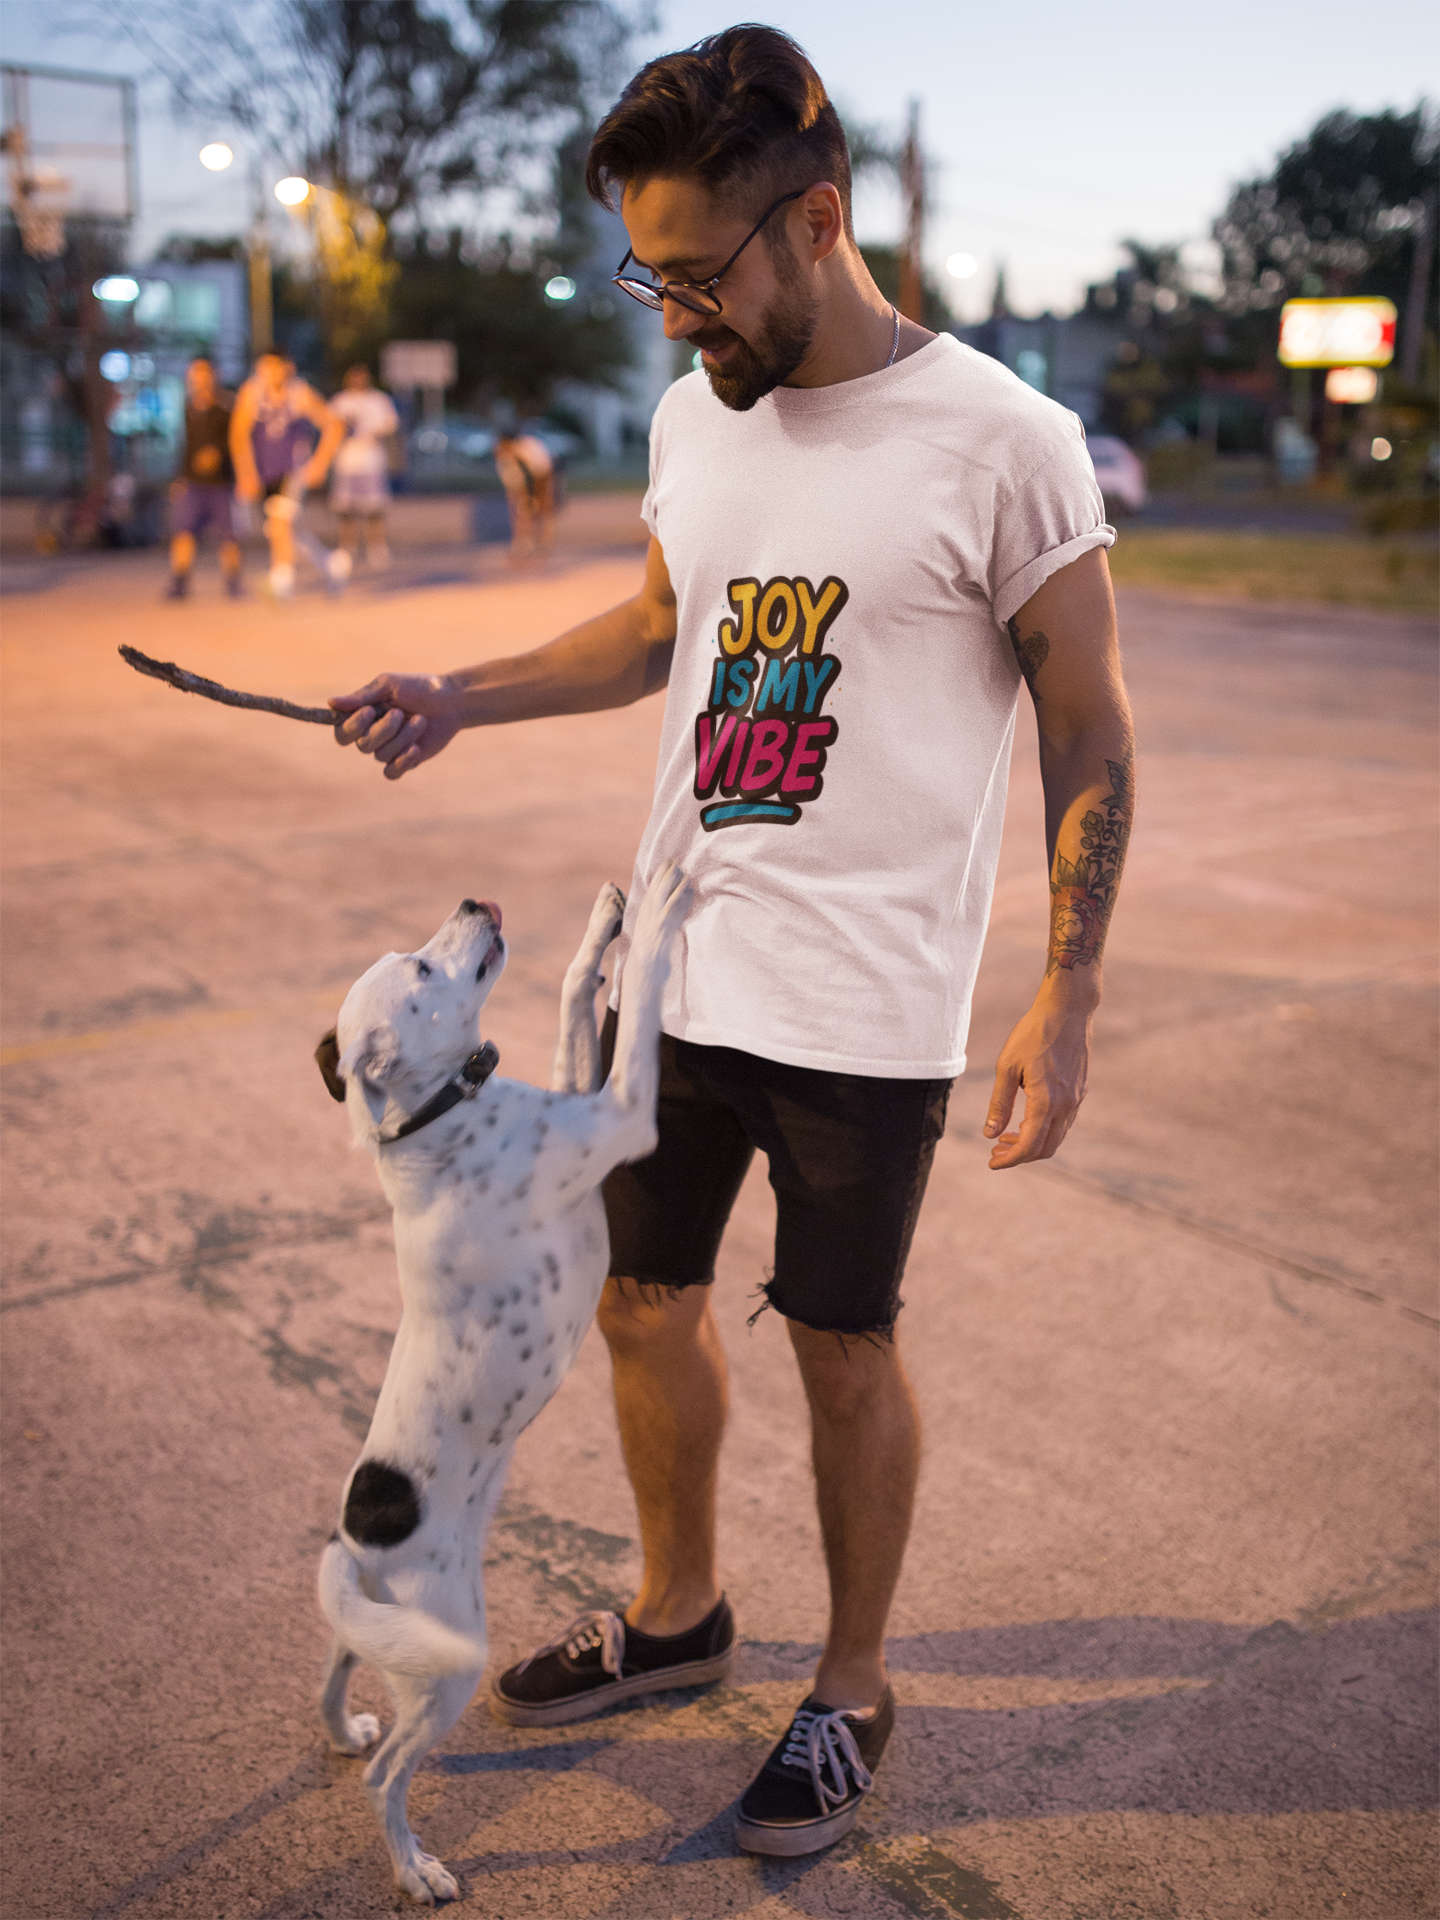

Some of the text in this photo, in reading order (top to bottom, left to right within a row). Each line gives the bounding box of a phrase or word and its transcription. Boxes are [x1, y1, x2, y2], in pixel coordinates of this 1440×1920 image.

[719, 577, 847, 655] JOY
[709, 655, 838, 714] IS MY
[695, 713, 837, 799] VIBE
